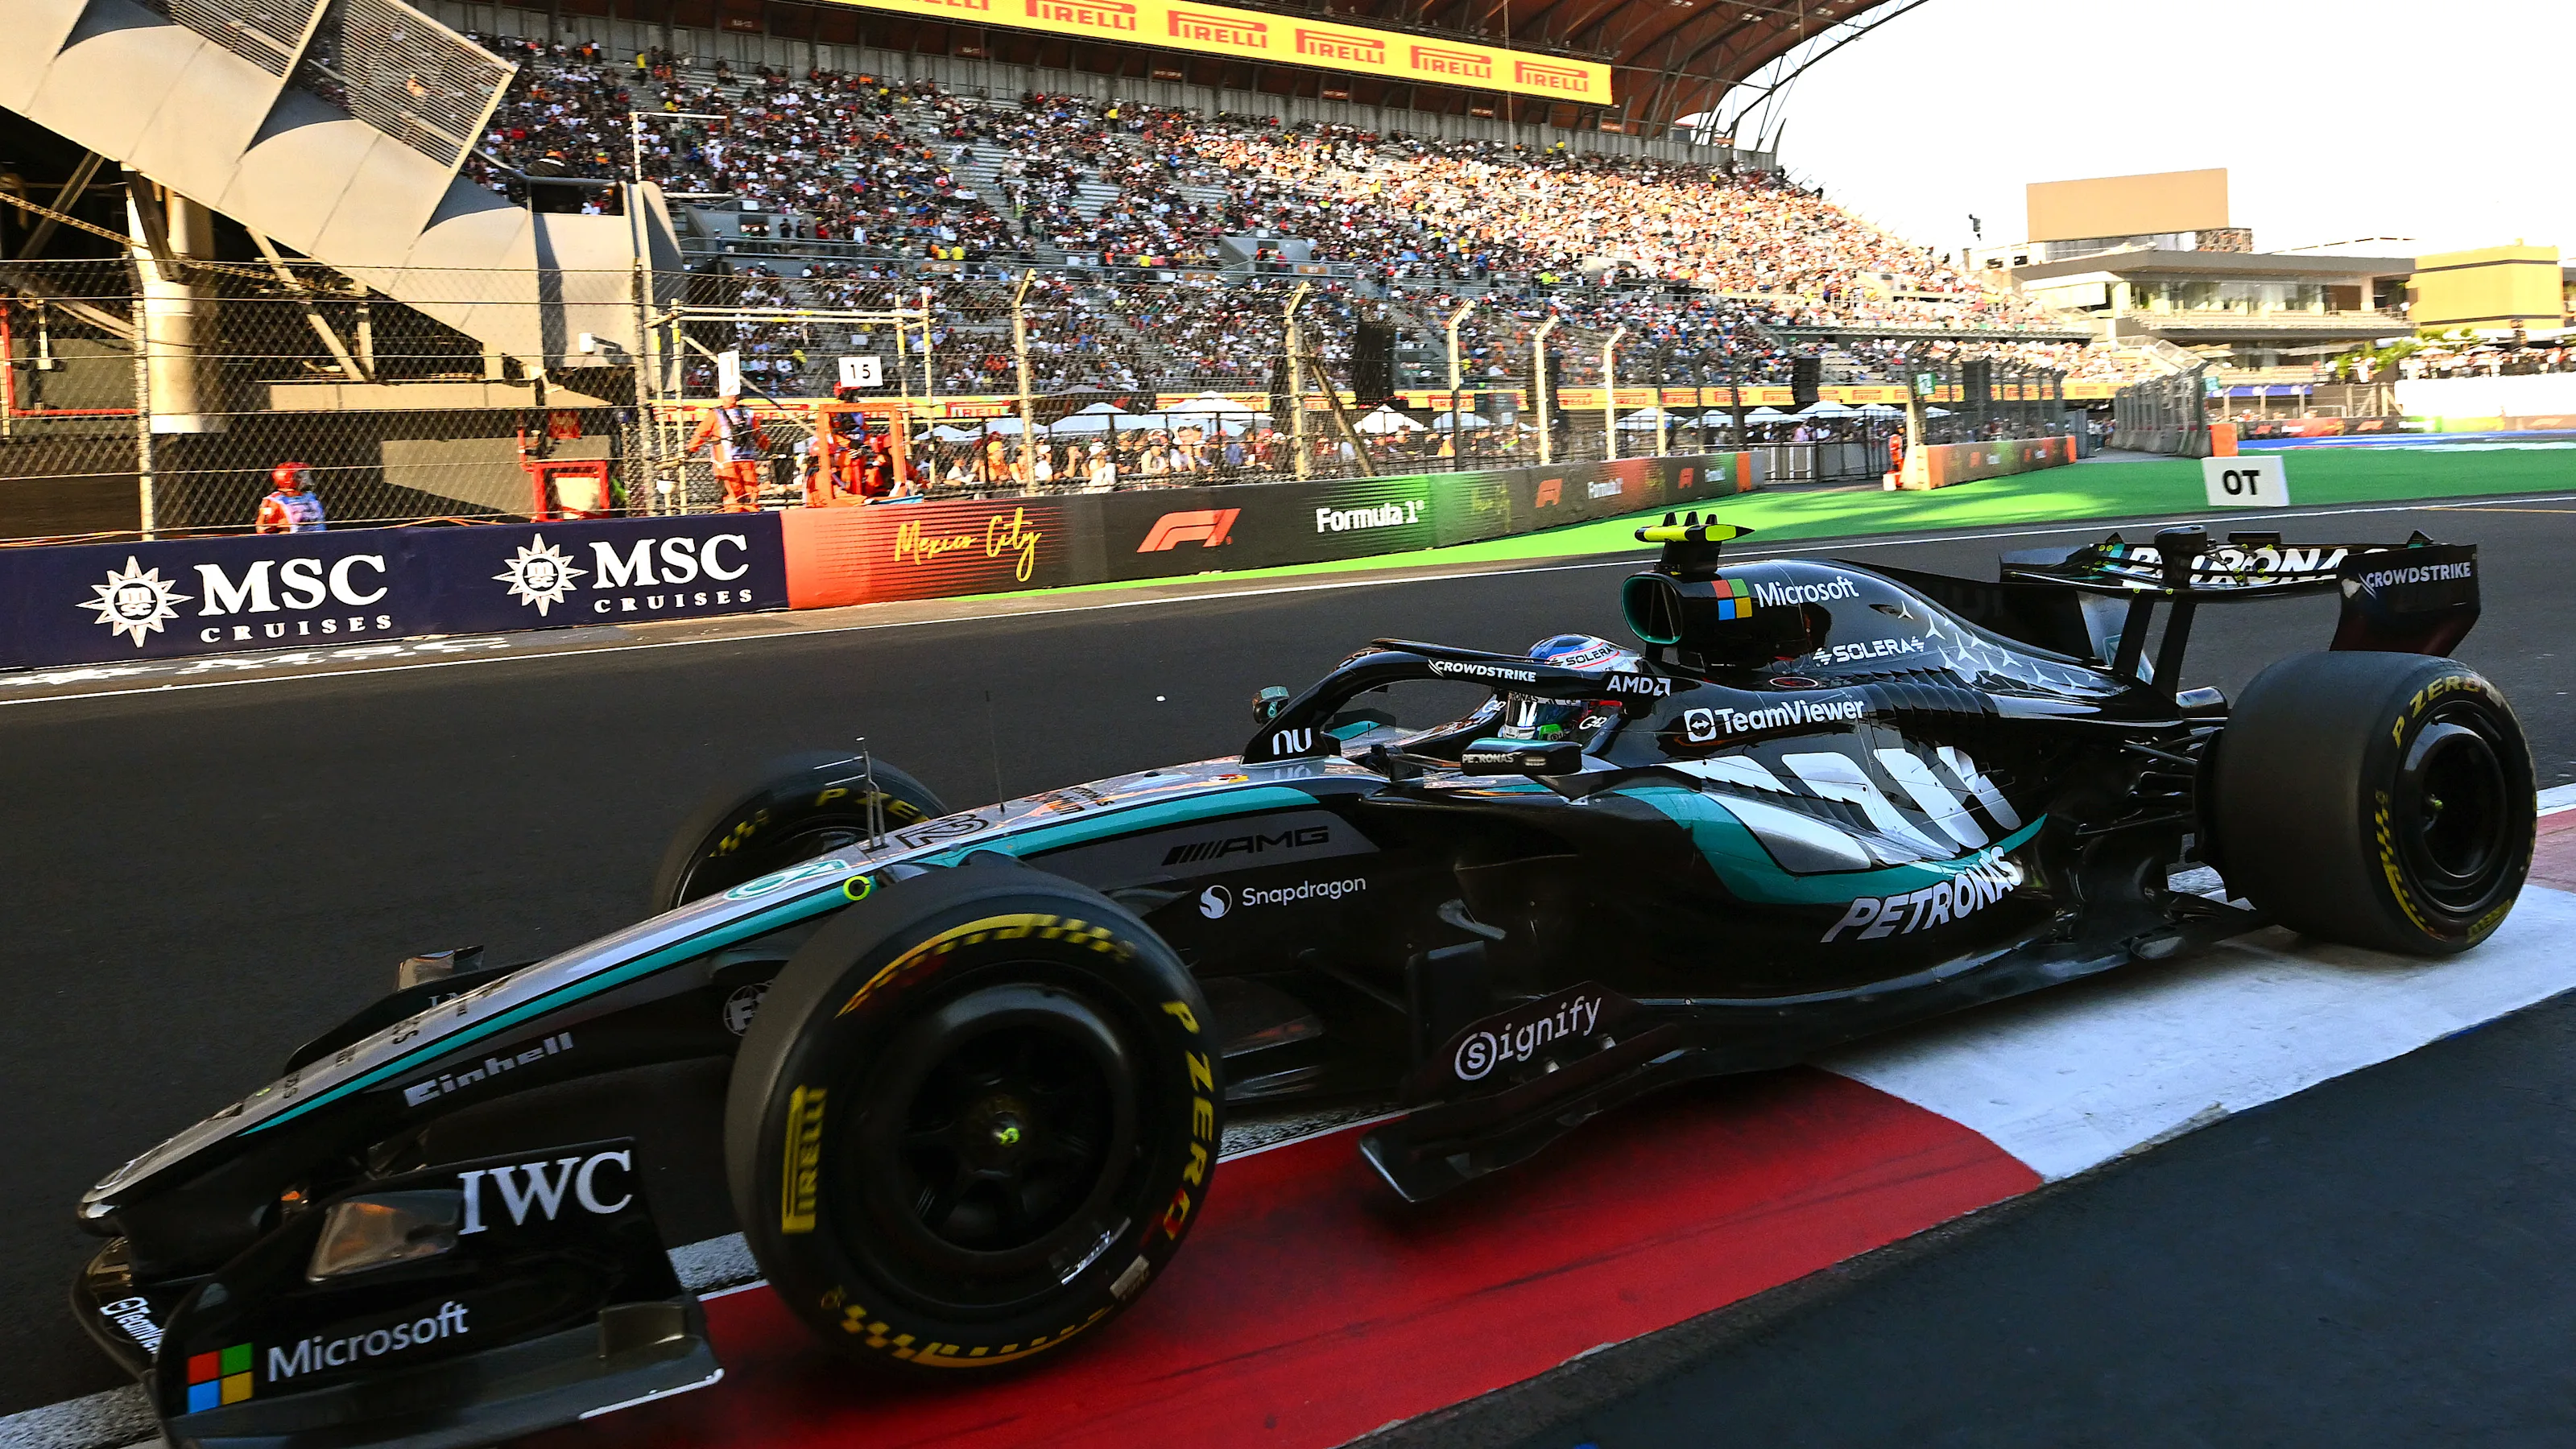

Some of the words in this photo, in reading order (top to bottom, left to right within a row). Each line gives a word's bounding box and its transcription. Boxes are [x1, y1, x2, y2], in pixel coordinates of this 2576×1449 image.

[1026, 0, 1137, 31] PIRELLI
[1167, 10, 1268, 48] PIRELLI
[1295, 28, 1386, 64] PIRELLI
[1410, 45, 1492, 79] PIRELLI
[1514, 60, 1589, 93] PIRELLI
[850, 364, 871, 379] 15
[2222, 469, 2260, 496] OT
[1315, 502, 1404, 534] Formula
[893, 519, 978, 566] Mexico
[985, 506, 1042, 583] City
[589, 533, 751, 590] MSC
[2366, 562, 2471, 588] CROWDSTRIKE
[192, 553, 388, 617] MSC
[593, 588, 753, 613] CRUISES
[1755, 576, 1860, 609] Microsoft
[199, 615, 392, 643] CRUISES
[1565, 644, 1614, 667] SOLERA
[1834, 638, 1916, 663] SOLERA
[1435, 659, 1536, 683] CROWDSTRIKE
[1606, 675, 1654, 695] AMD
[1578, 716, 1608, 730] G42
[1714, 699, 1865, 736] TeamViewer
[1462, 753, 1515, 764] PETRONAS
[1215, 825, 1329, 859] AMG
[1242, 877, 1367, 907] Snapdragon
[1819, 845, 2024, 943] PETRONAS
[403, 1030, 574, 1108] Einhell
[781, 1084, 828, 1234] PIRELLI
[1163, 1049, 1216, 1242] ZERO
[457, 1149, 635, 1237] IWC
[268, 1300, 471, 1384] Microsoft
